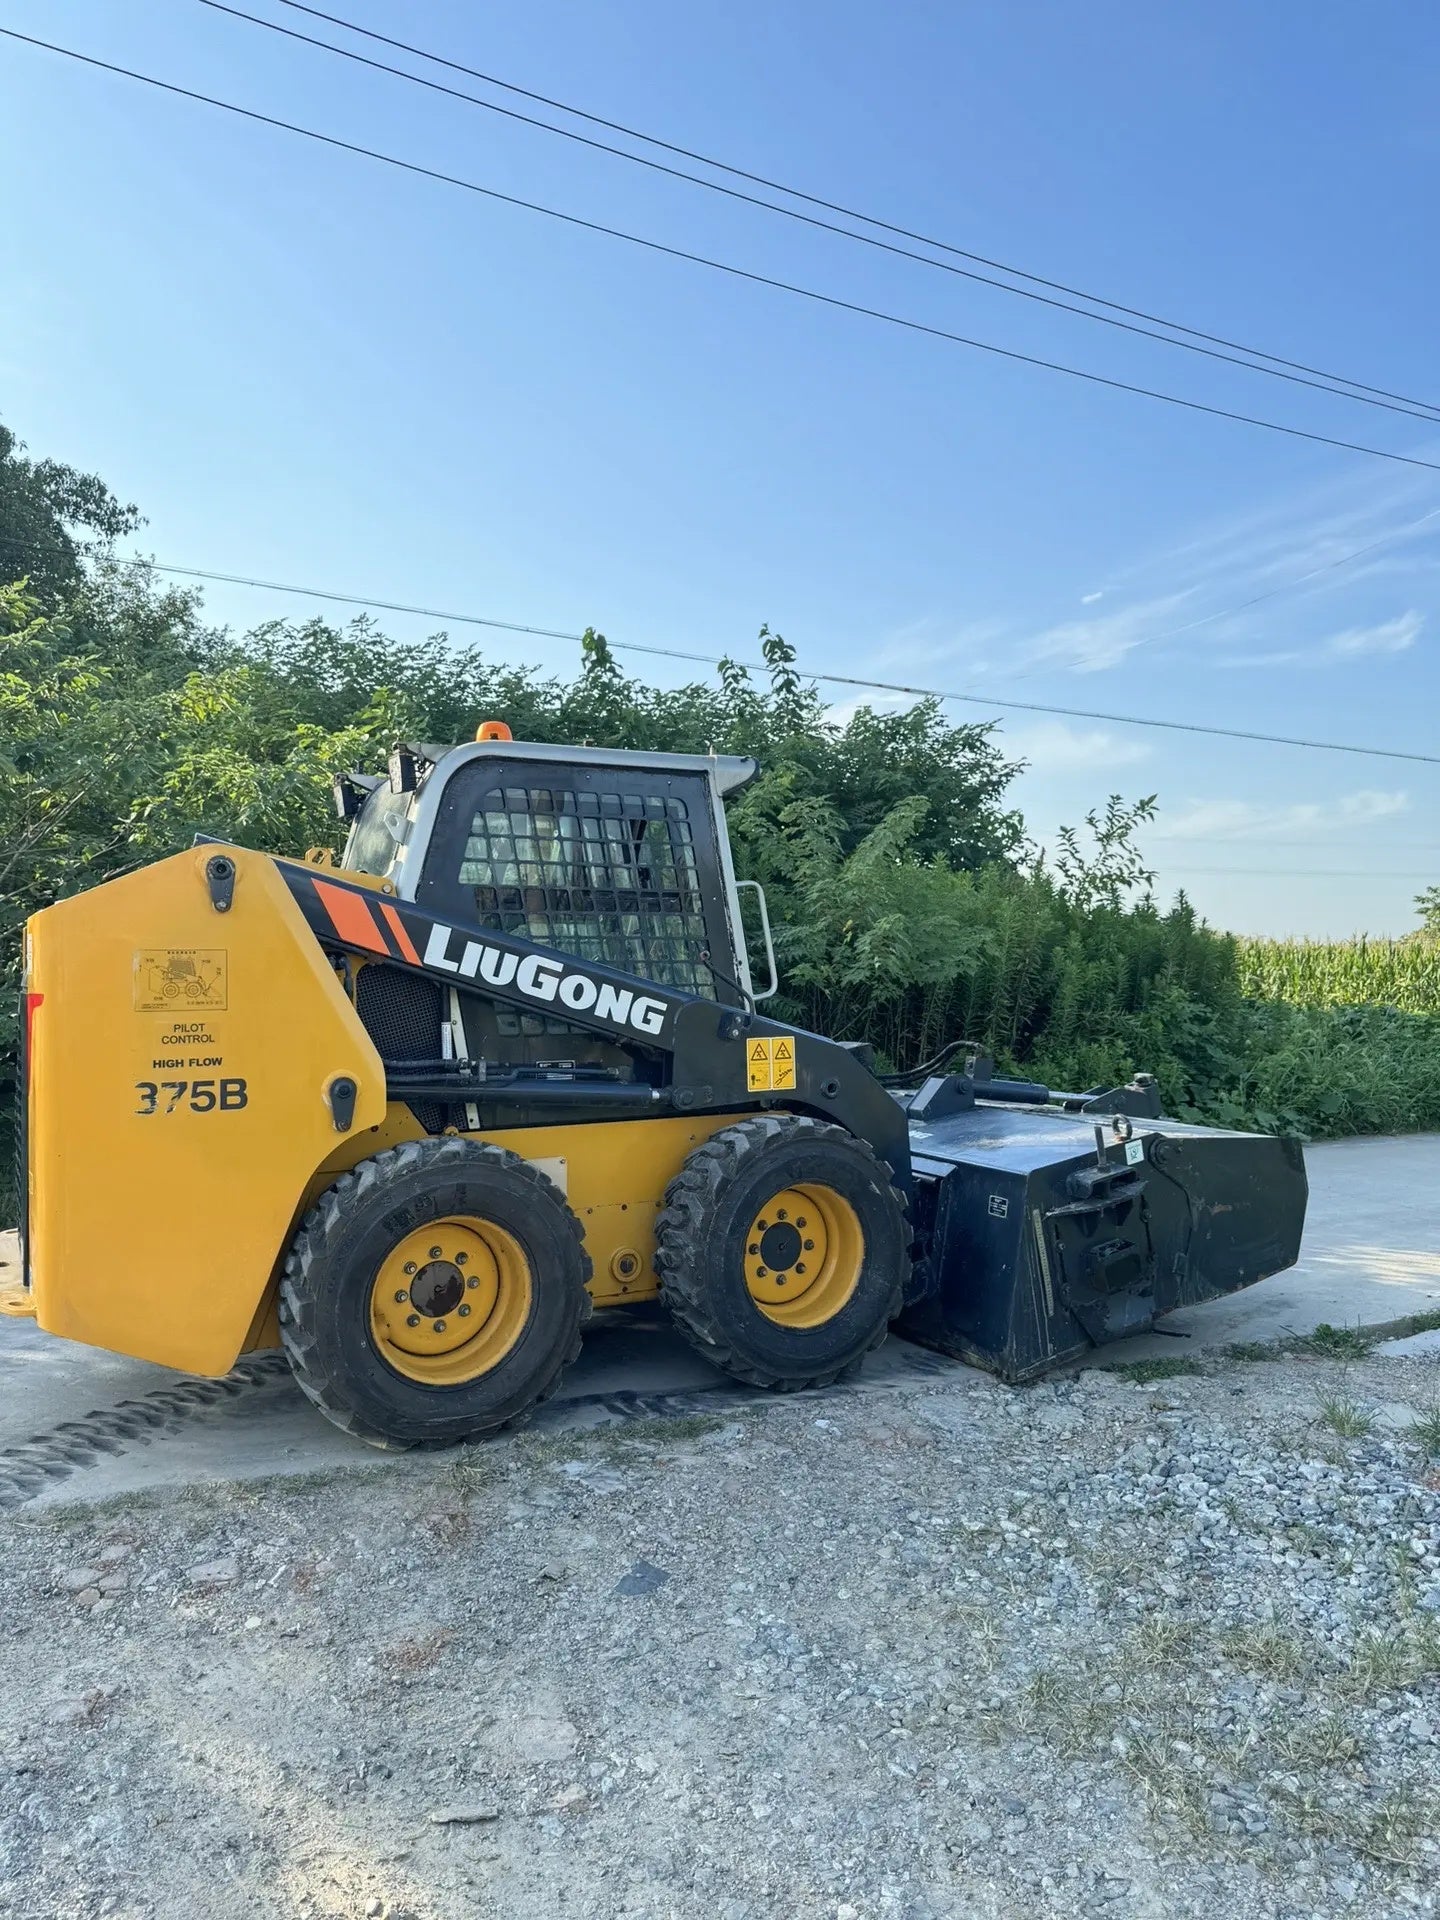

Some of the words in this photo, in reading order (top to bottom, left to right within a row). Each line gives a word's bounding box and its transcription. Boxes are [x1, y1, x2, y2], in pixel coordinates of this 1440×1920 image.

[173, 1023, 205, 1033] PILOT
[161, 1034, 215, 1045] CONTROL
[153, 1059, 184, 1068] HIGH
[189, 1057, 223, 1067] FLOW
[135, 1078, 248, 1115] 375B
